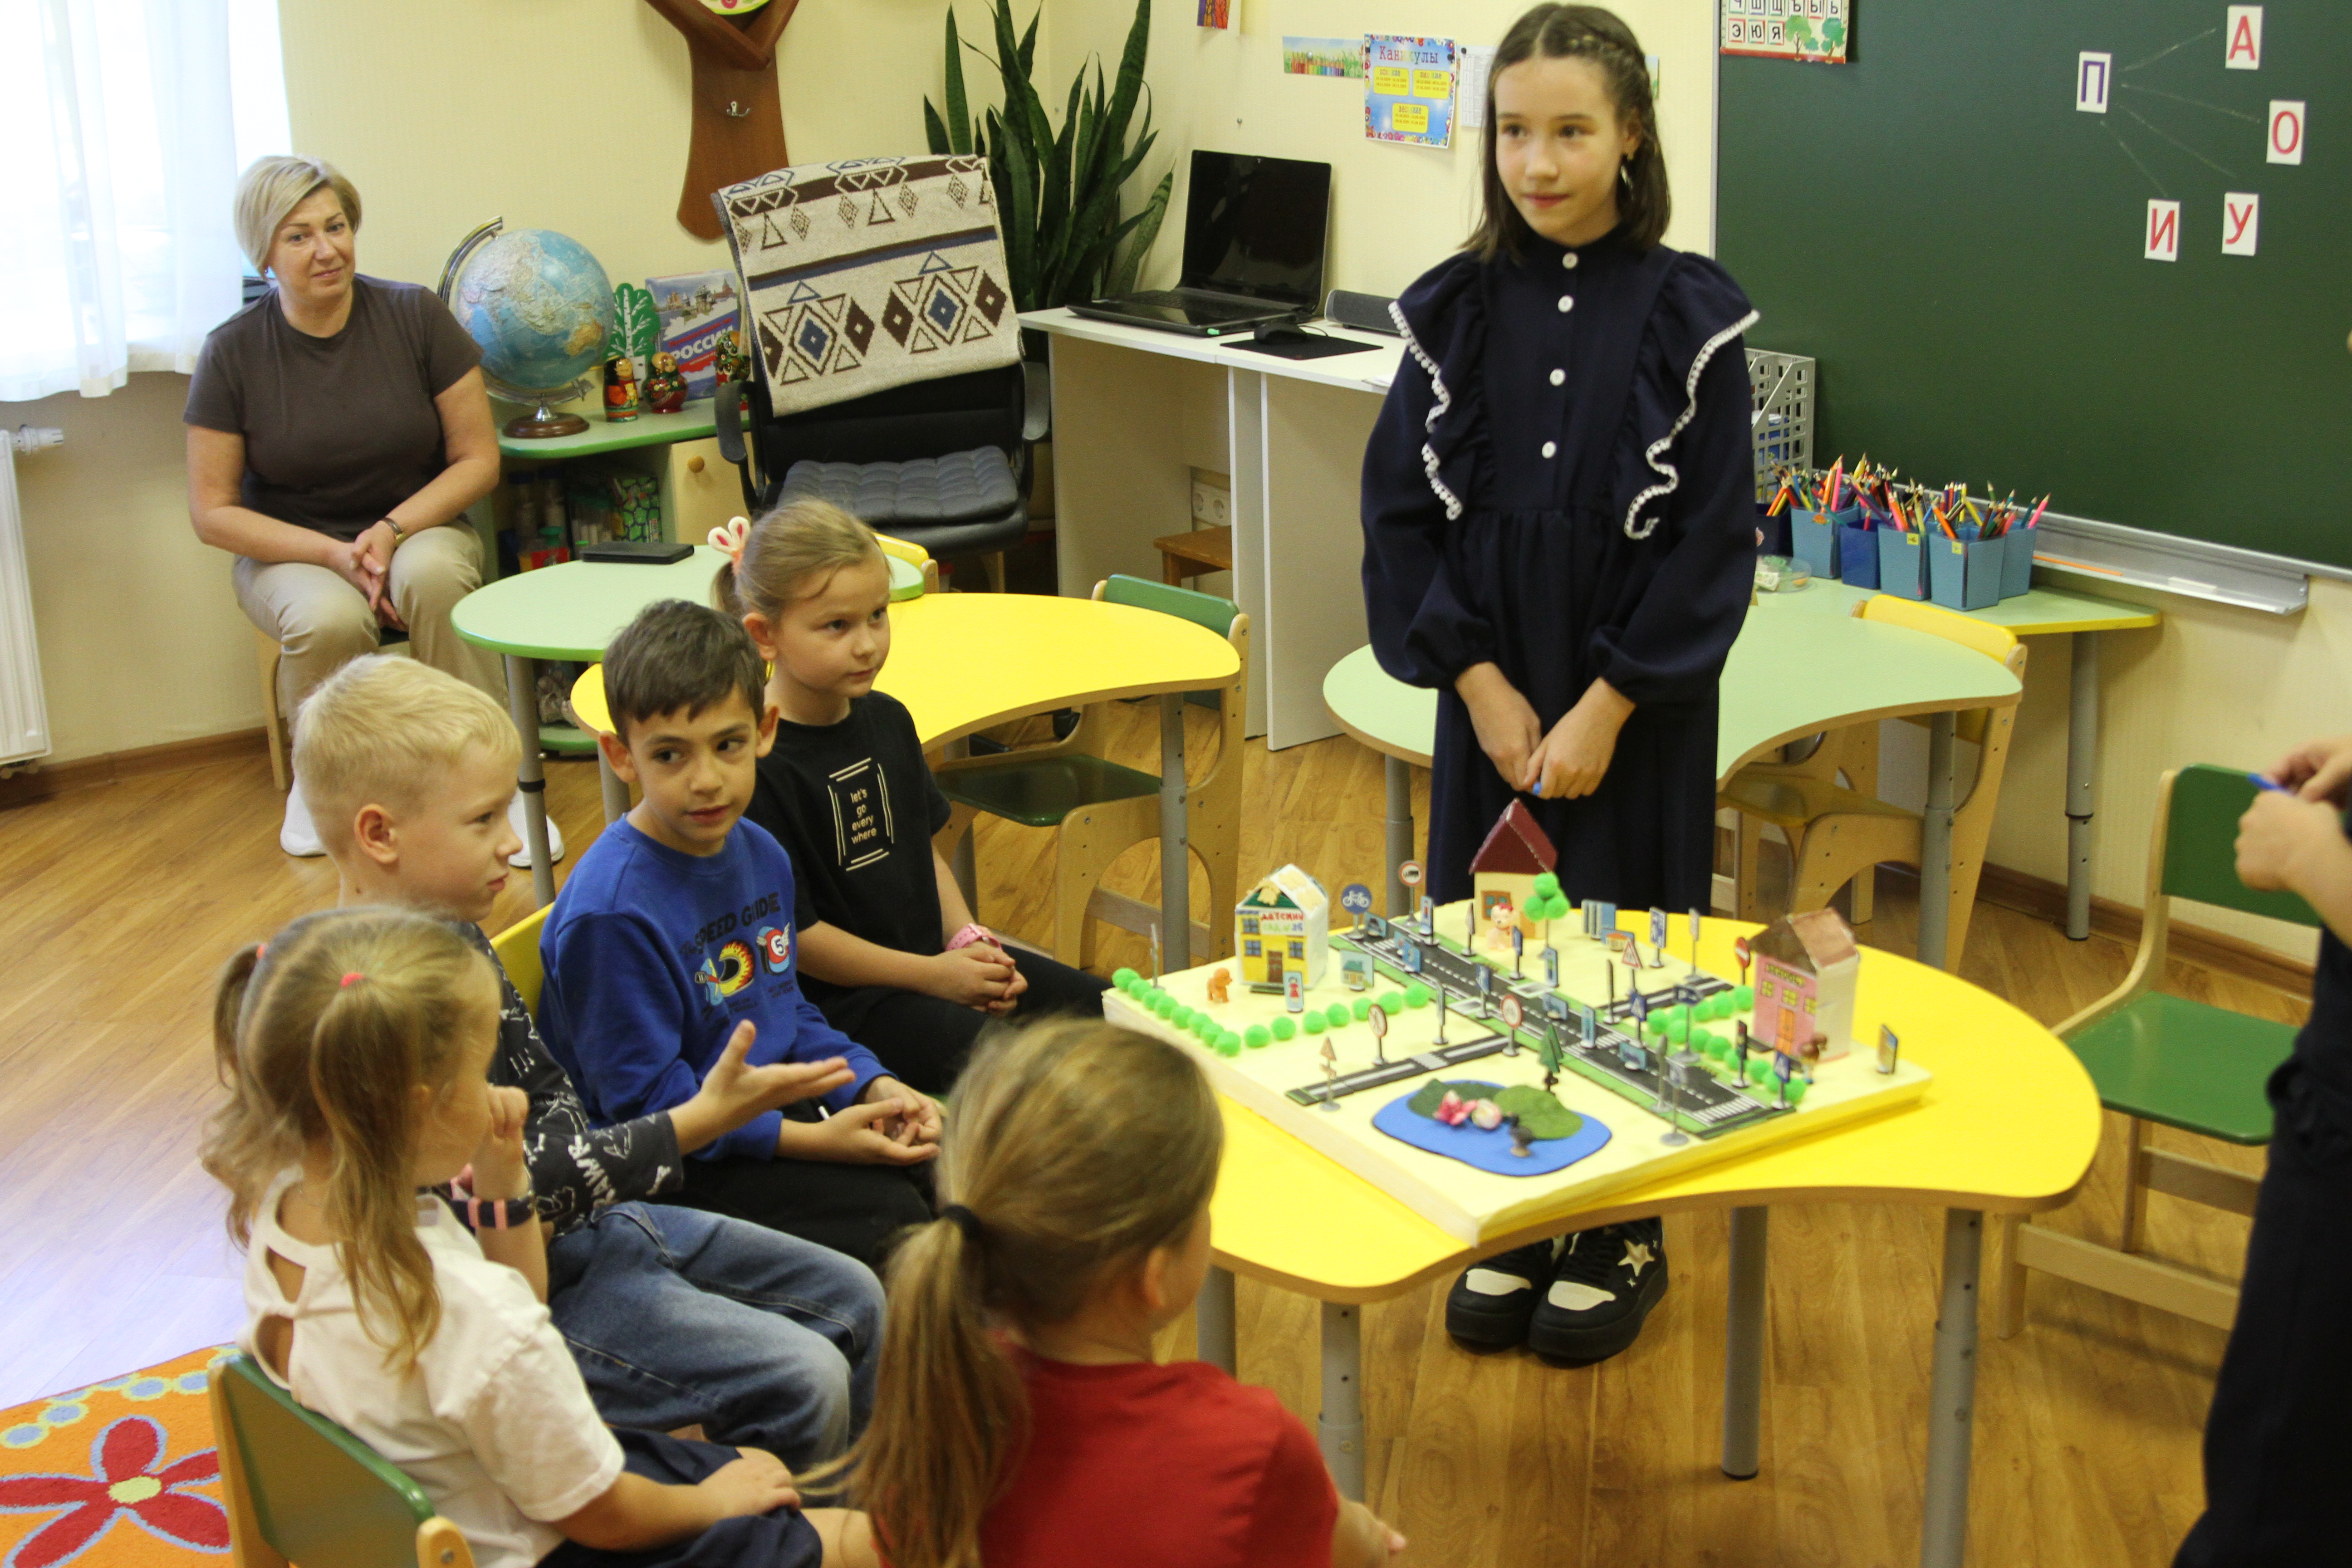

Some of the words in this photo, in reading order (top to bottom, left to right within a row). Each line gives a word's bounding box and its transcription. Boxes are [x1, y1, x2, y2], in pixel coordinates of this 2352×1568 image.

[1772, 0, 1782, 15] Щ
[1811, 0, 1821, 13] Ы
[1831, 1, 1838, 14] Ь
[1732, 24, 1741, 37] Э
[1752, 24, 1762, 38] Ю
[1772, 26, 1780, 39] Я
[2228, 15, 2257, 61] А
[2081, 60, 2105, 104] П
[2272, 111, 2299, 154] О
[2149, 208, 2176, 253] И
[2225, 202, 2254, 244] У
[850, 788, 867, 803] let's
[856, 804, 867, 818] go
[852, 815, 873, 831] every
[851, 827, 877, 844] where
[774, 938, 784, 954] 5
